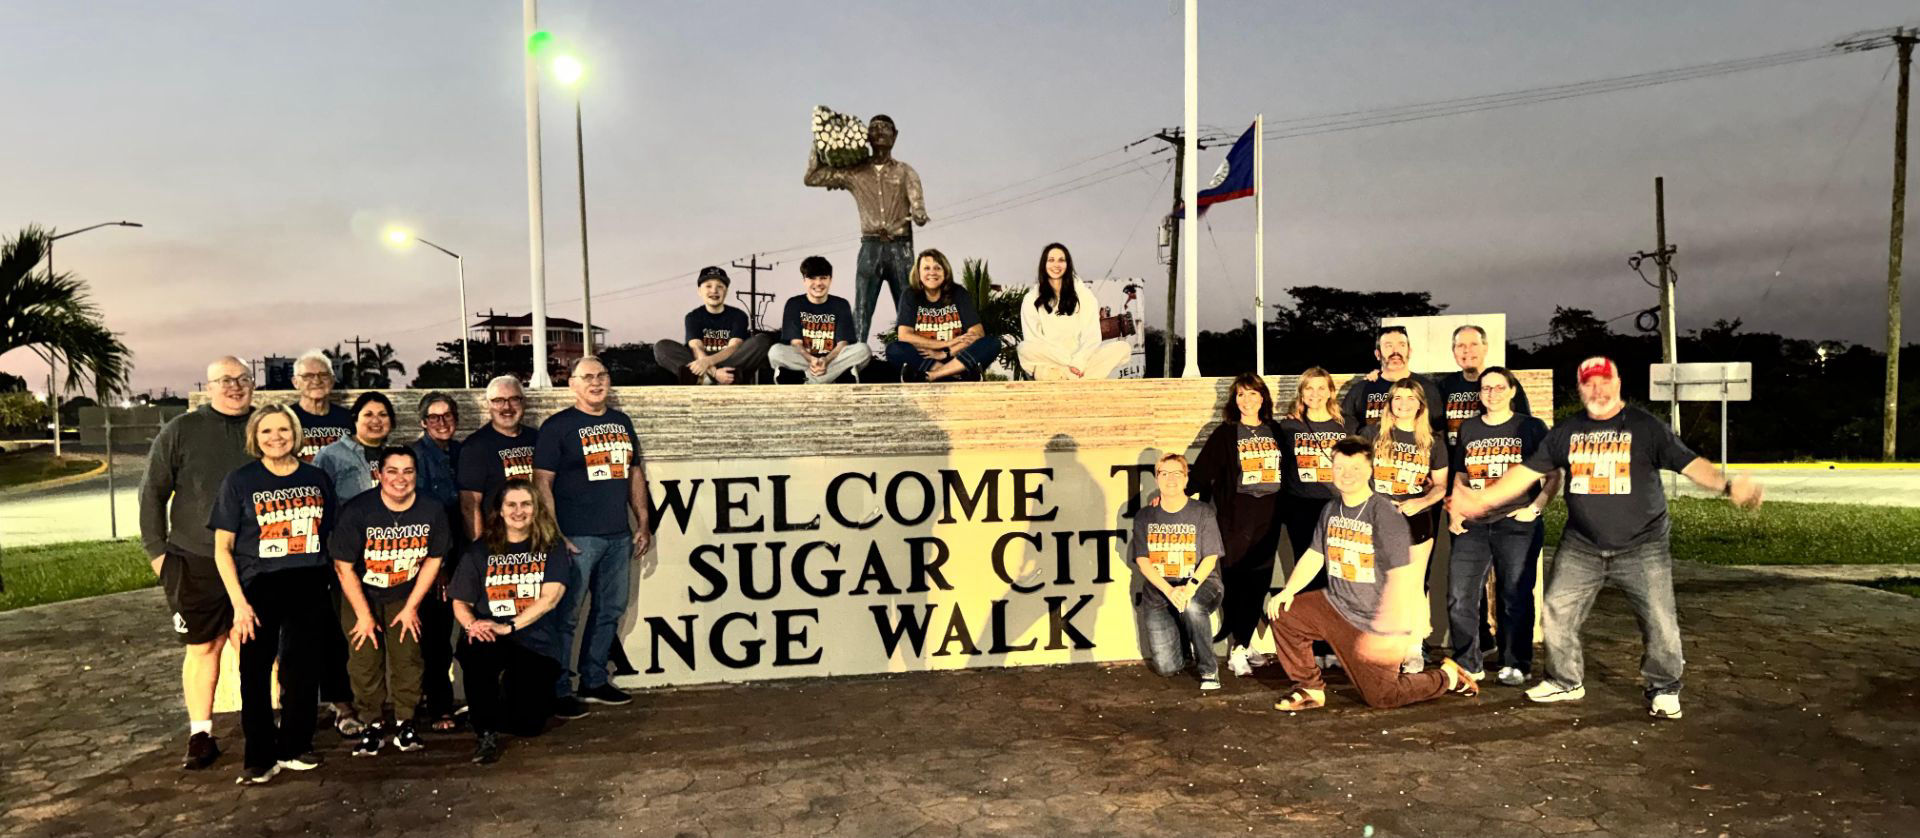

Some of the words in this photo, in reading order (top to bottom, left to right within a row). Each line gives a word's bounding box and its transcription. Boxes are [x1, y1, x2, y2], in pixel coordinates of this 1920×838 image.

[1448, 391, 1480, 402] PRAYI
[1294, 432, 1347, 441] PRAYING
[1466, 438, 1522, 449] PRAYING
[498, 446, 534, 460] PRAYI
[504, 464, 533, 477] MISSI
[253, 486, 321, 504] PRAYING
[648, 468, 1060, 535] WELCOME
[367, 524, 430, 539] PRAYING
[1147, 523, 1196, 534] PRAYING
[366, 536, 428, 550] PELICAN
[688, 536, 954, 604] SUGAR
[991, 529, 1128, 593] CIT
[607, 608, 824, 676] ANGE
[869, 594, 1096, 658] WALK
